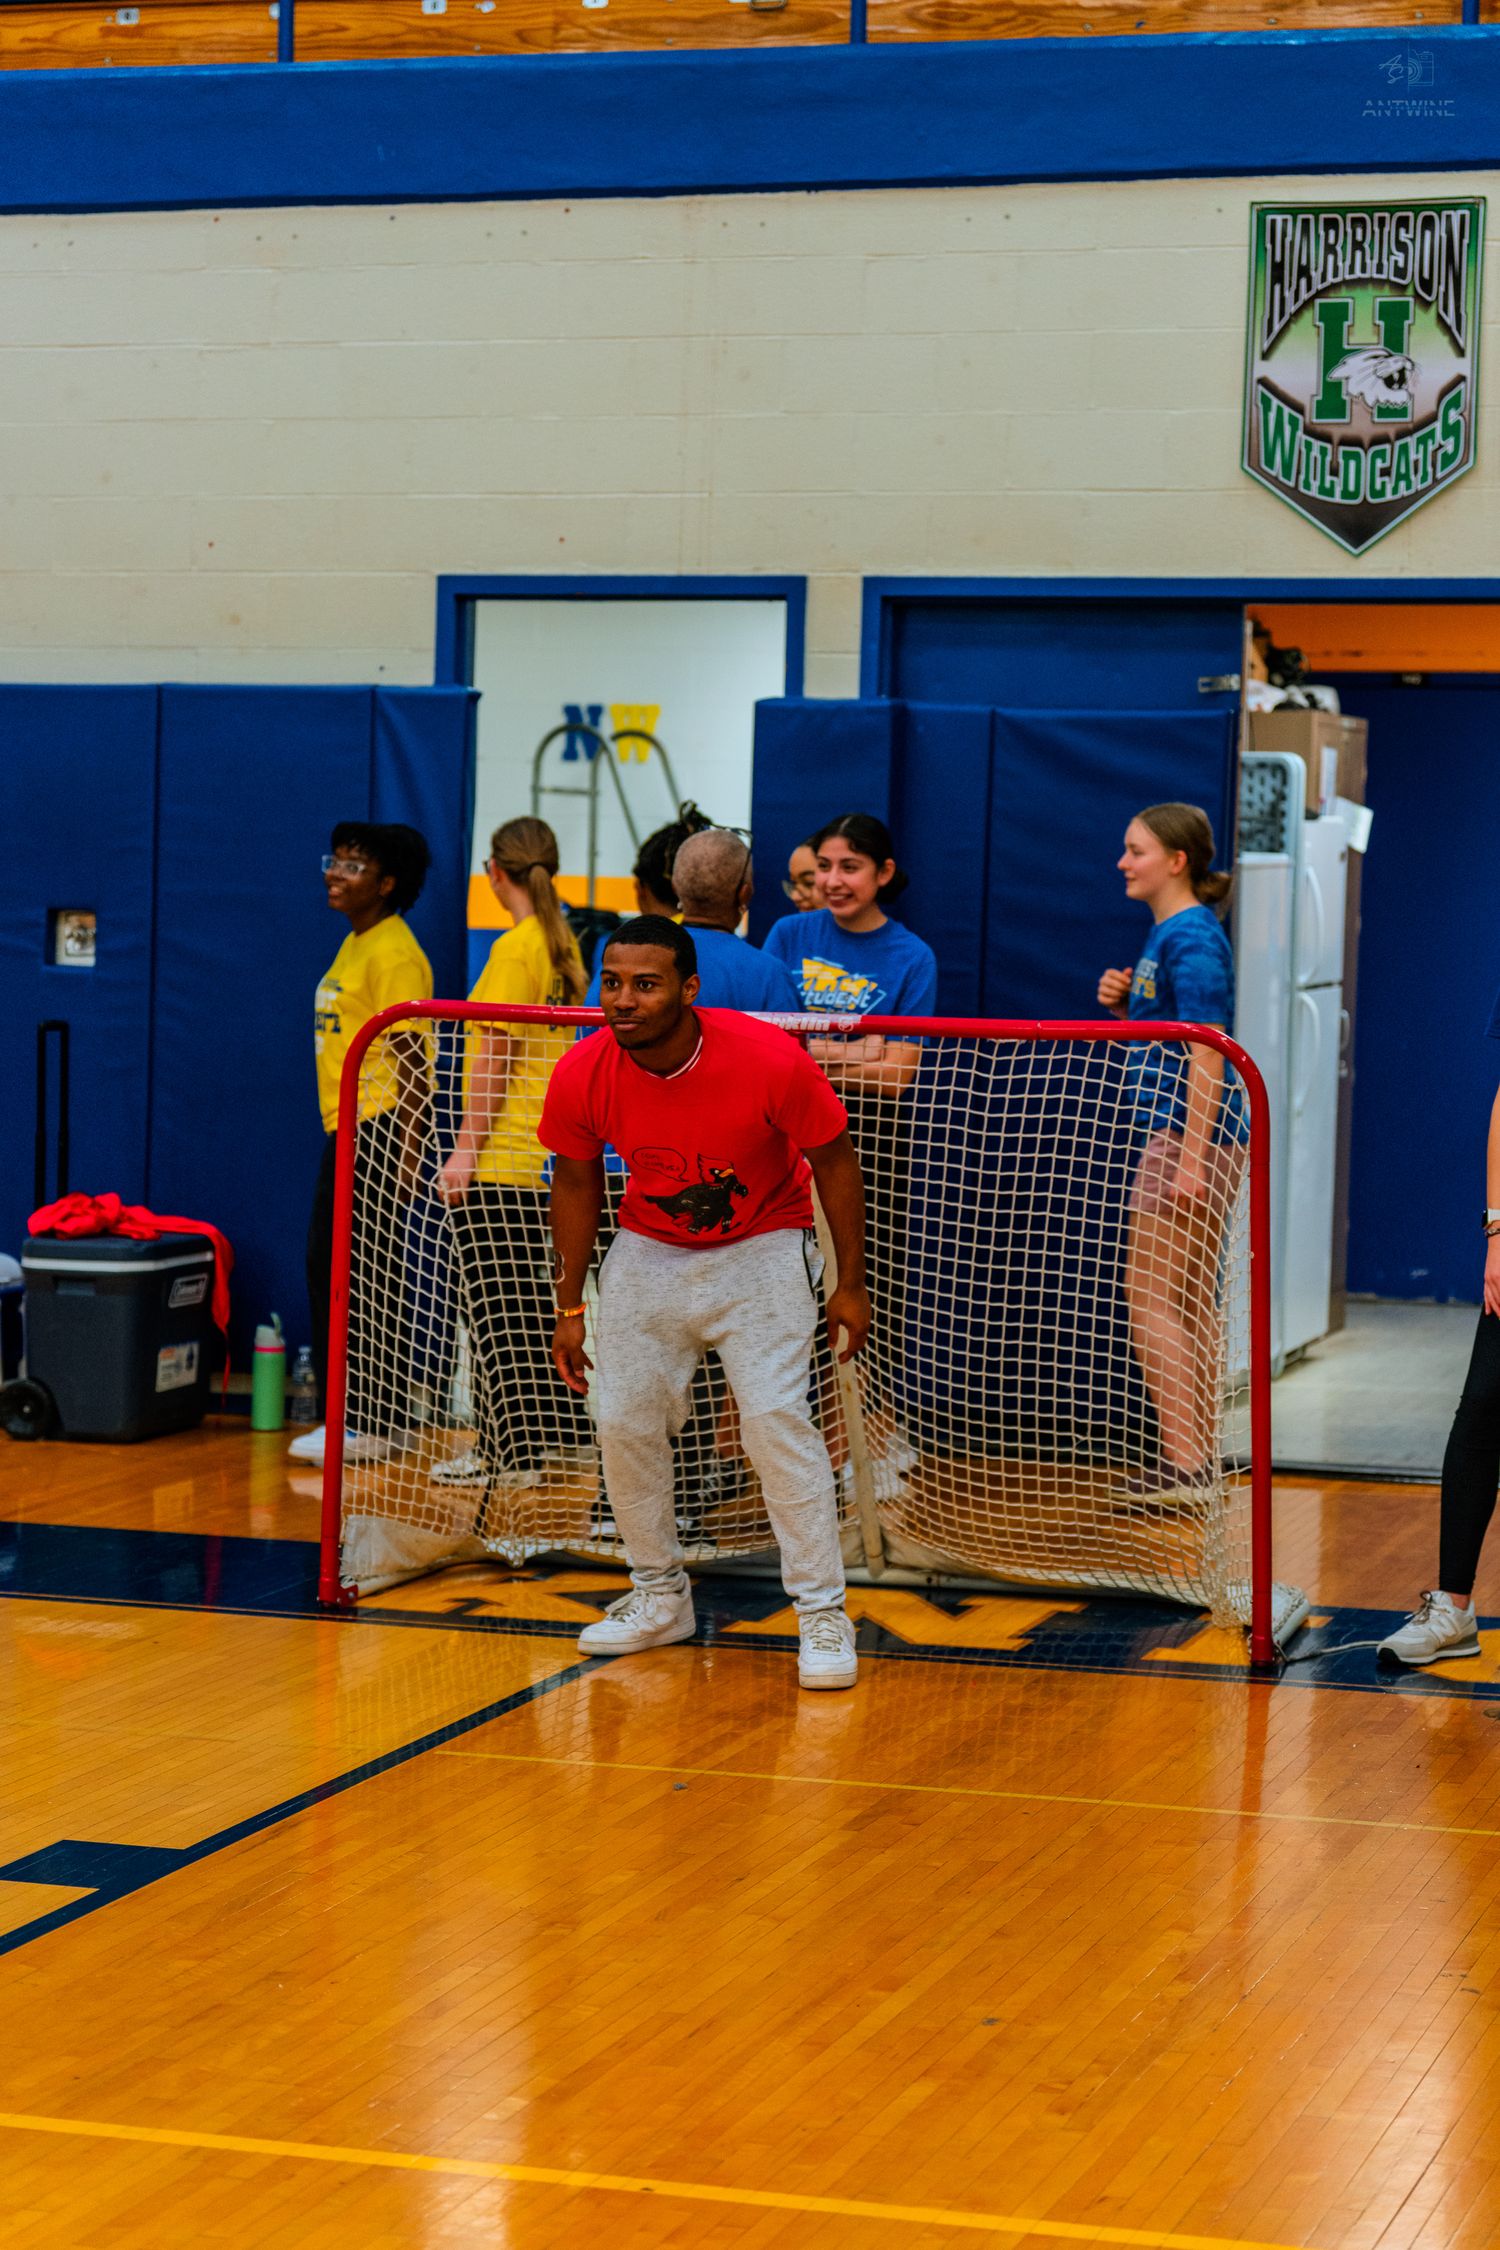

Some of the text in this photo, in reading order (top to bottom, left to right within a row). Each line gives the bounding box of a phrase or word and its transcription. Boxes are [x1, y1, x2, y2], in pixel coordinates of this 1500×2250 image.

[1261, 209, 1470, 360] HARRISON
[1311, 296, 1415, 424] H
[1257, 384, 1467, 506] WILDCATS
